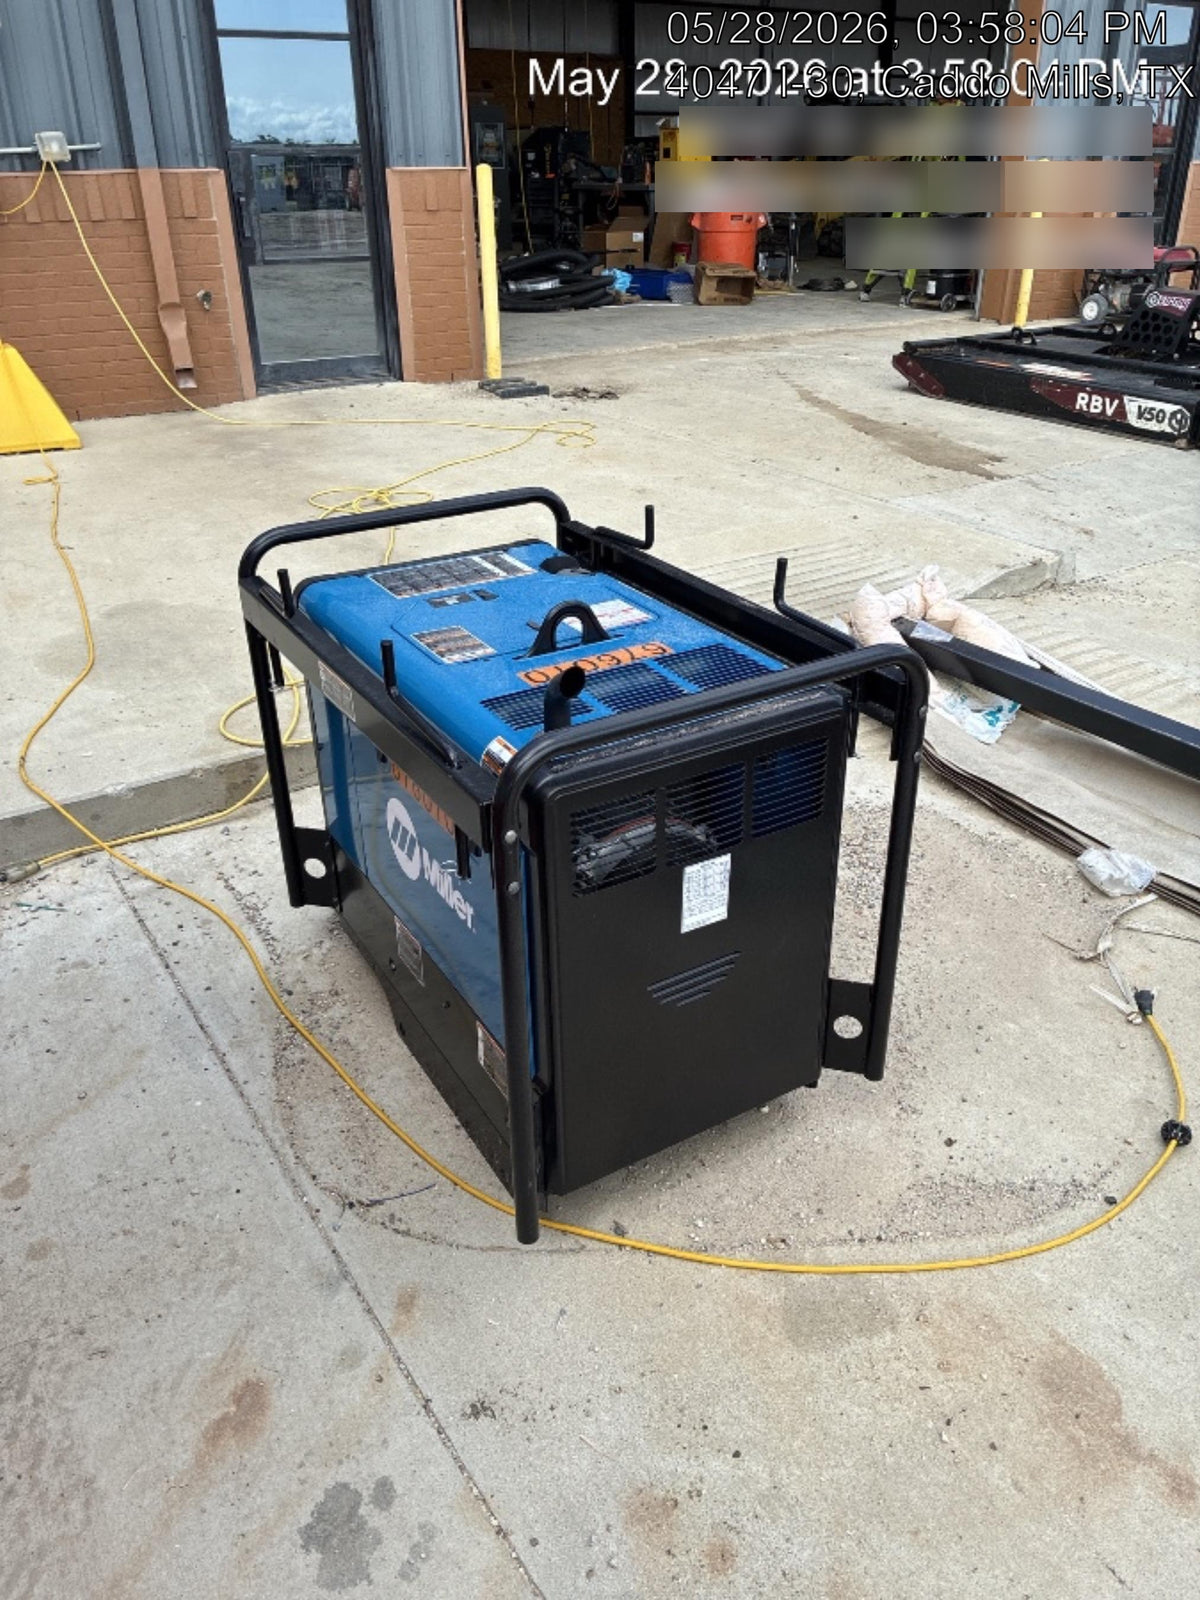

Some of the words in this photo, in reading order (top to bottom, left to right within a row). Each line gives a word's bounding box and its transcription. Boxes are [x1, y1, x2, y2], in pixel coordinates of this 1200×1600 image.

[1075, 392, 1119, 417] RBV
[1137, 405, 1167, 424] V50
[422, 847, 474, 929] Miller
